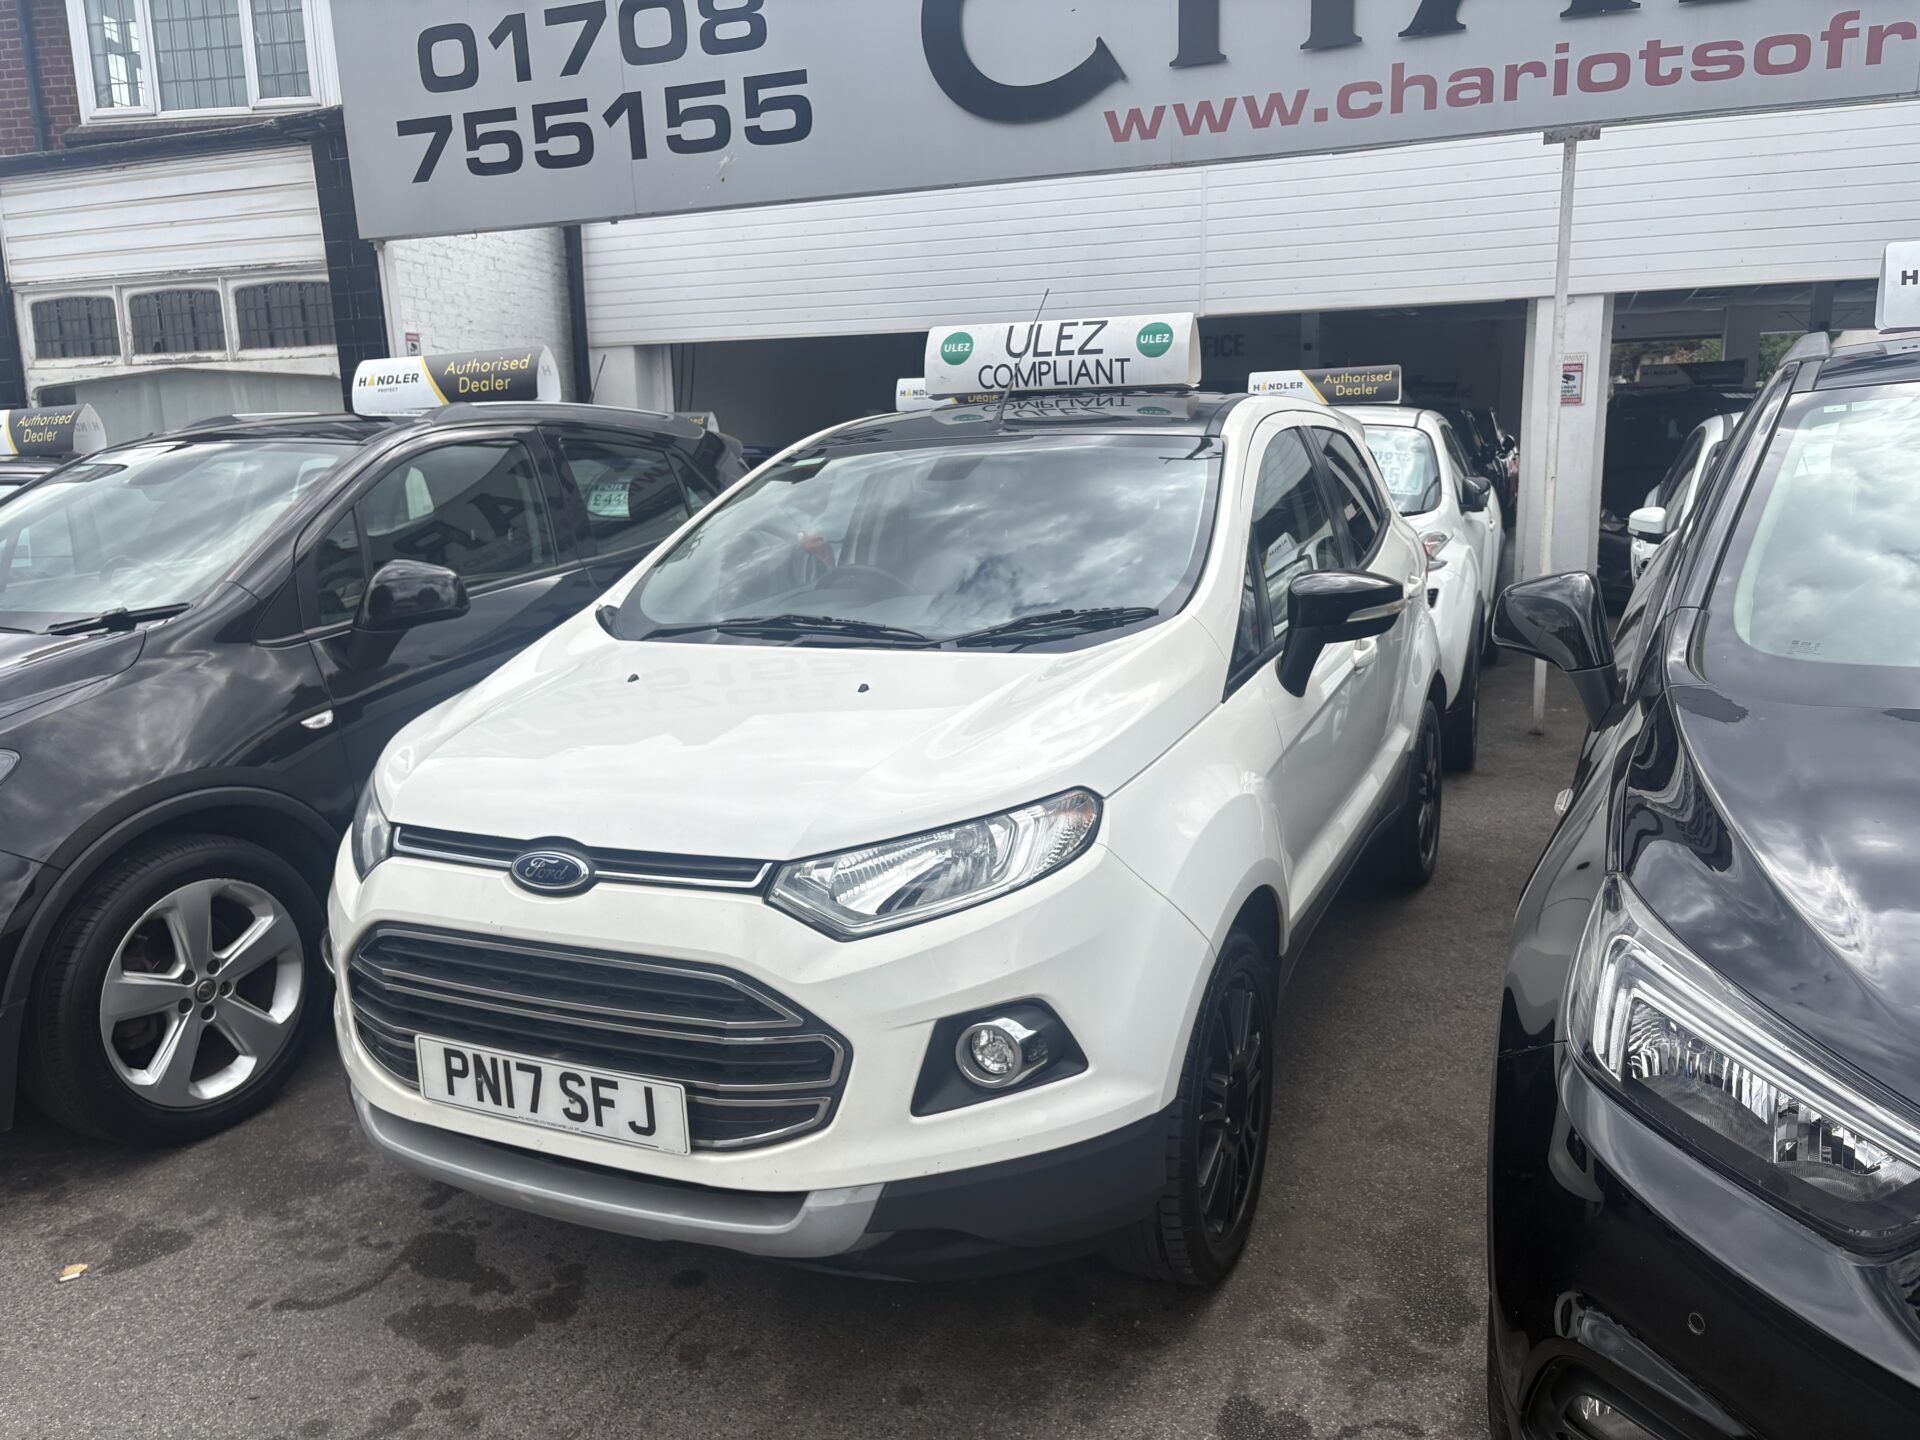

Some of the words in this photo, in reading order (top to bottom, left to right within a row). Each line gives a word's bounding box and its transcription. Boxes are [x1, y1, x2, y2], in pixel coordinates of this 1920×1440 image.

[417, 0, 767, 93] 01708
[1103, 9, 1918, 143] www.chariotsofr
[396, 69, 813, 184] 755155
[944, 342, 971, 353] ULEZ
[1005, 320, 1109, 358] ULEZ
[1140, 332, 1170, 344] ULEZ
[443, 353, 532, 377] Authorised
[978, 358, 1131, 389] COMPLIANT
[458, 374, 511, 394] Dealer
[1323, 370, 1393, 385] Authorised
[1335, 384, 1379, 397] Dealer
[17, 410, 76, 428] Authorised
[23, 427, 58, 443] Dealer
[525, 857, 569, 880] Ford
[442, 1047, 543, 1114] PN17
[558, 1071, 657, 1137] SFJ
